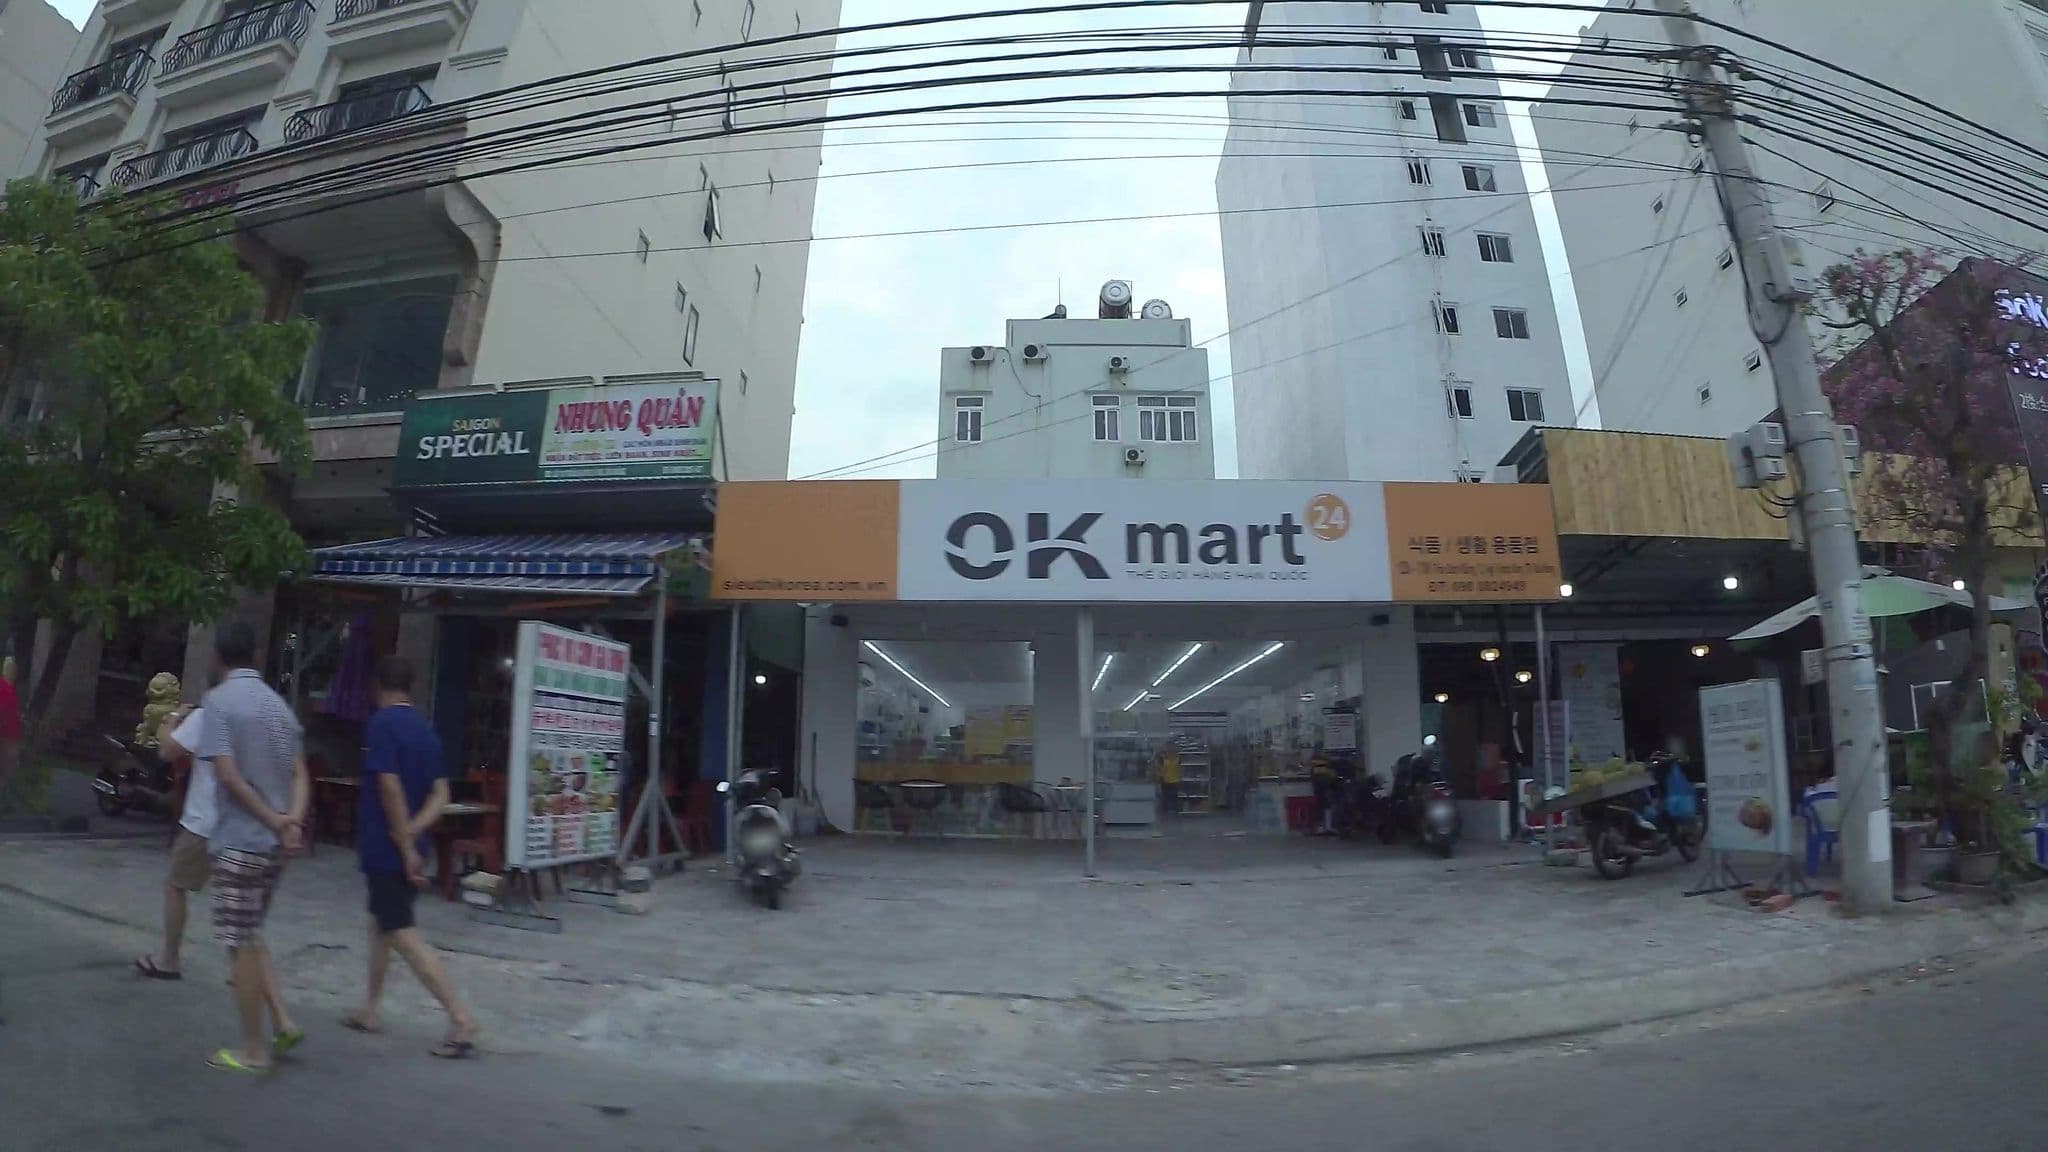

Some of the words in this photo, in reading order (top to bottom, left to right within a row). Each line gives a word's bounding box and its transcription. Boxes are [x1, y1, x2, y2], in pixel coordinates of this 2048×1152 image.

[451, 417, 502, 432] SAIGON
[416, 431, 531, 460] SPECIAL
[945, 511, 1111, 580] OK
[1125, 512, 1305, 565] mart
[1312, 505, 1346, 530] 24
